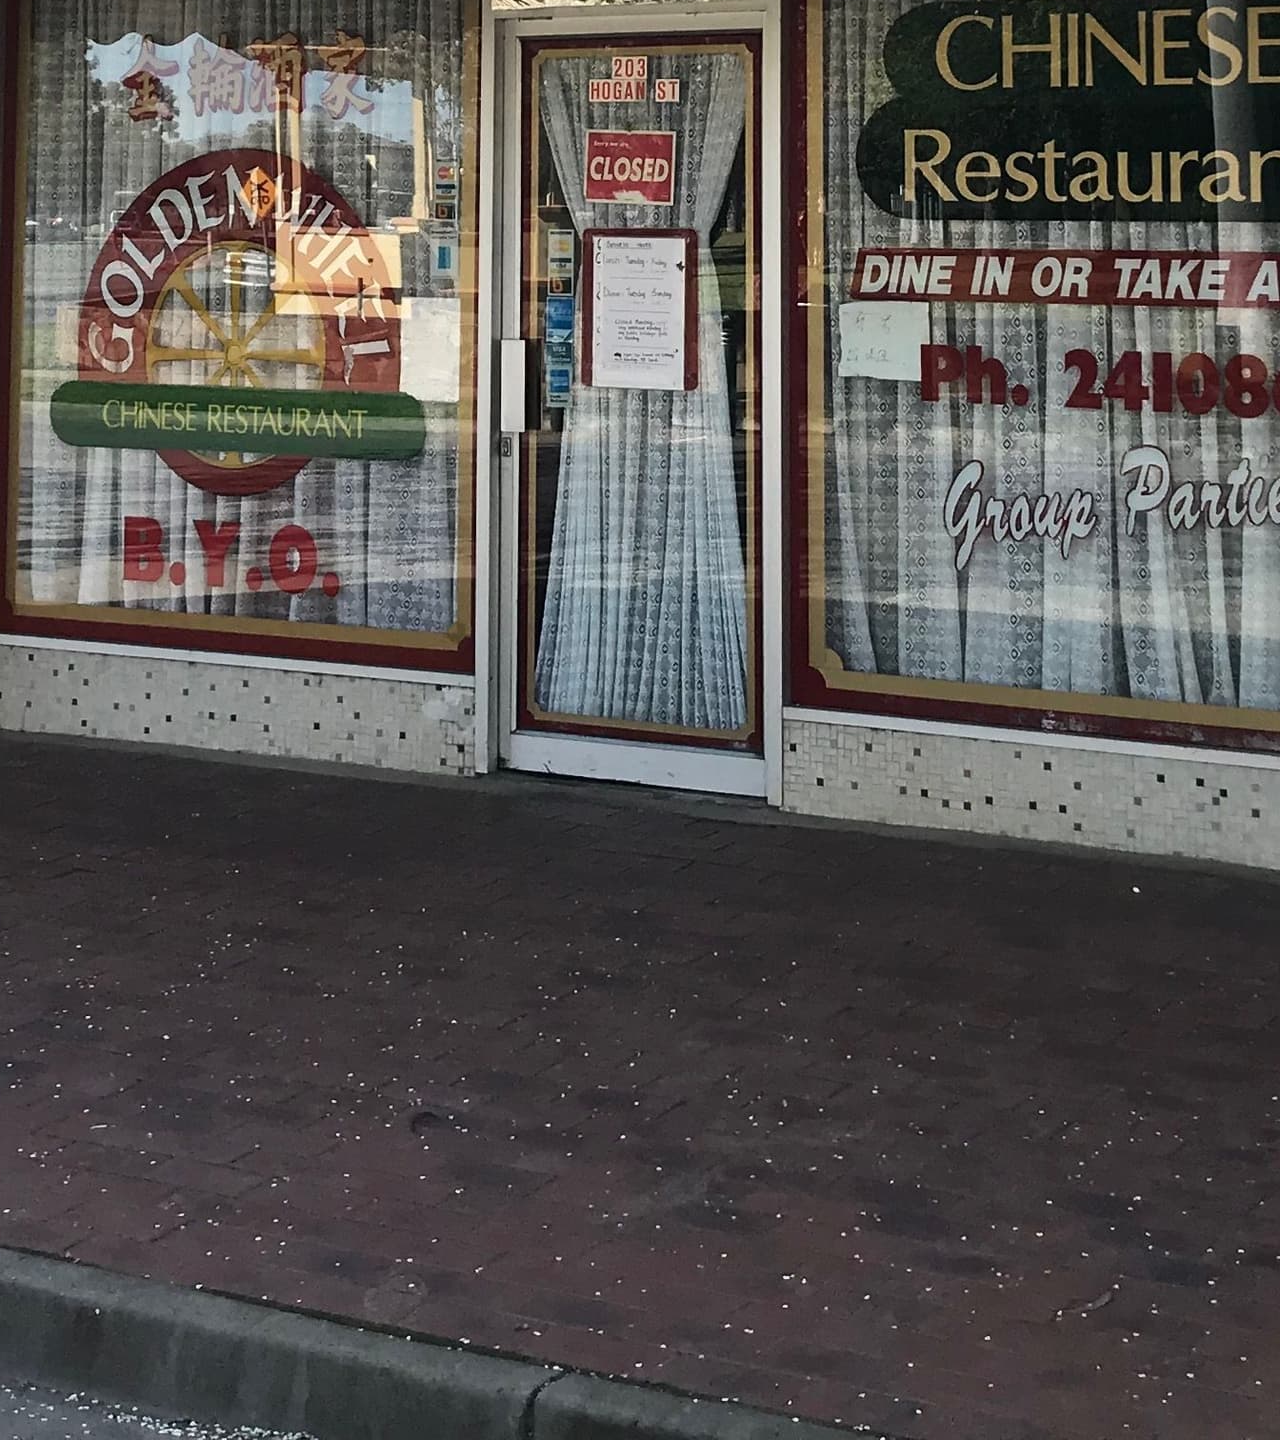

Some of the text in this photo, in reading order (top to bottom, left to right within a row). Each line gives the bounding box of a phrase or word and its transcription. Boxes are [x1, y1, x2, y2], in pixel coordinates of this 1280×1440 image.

[613, 58, 646, 78] 203
[590, 81, 678, 101] HOGAN ST
[589, 156, 669, 182] CLOSED
[88, 164, 391, 387] GOLDEN WHEEL
[860, 255, 957, 295] DINE
[970, 256, 1015, 296] IN
[1031, 257, 1093, 298] OR
[1114, 258, 1231, 300] TAKE
[920, 343, 1029, 407] Ph.
[102, 399, 369, 440] CHINESE RESTAURANT
[943, 459, 1099, 571] Group
[123, 515, 341, 598] B.Y.O.
